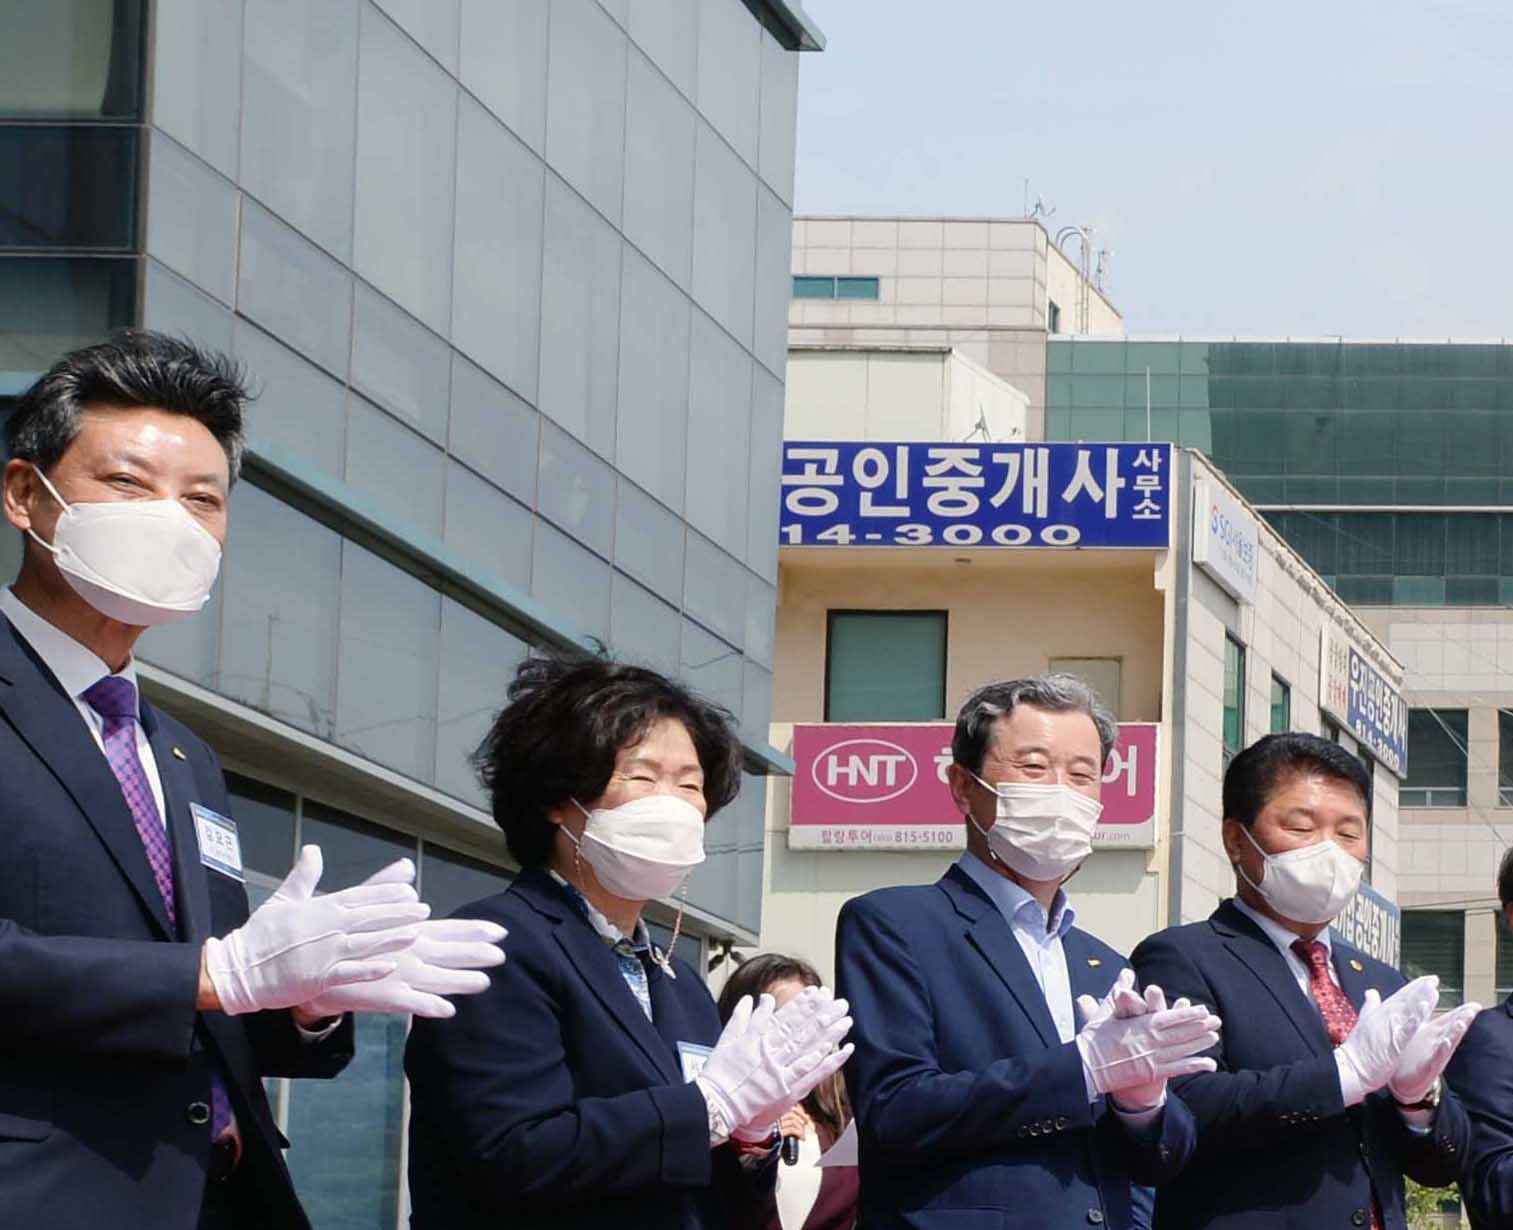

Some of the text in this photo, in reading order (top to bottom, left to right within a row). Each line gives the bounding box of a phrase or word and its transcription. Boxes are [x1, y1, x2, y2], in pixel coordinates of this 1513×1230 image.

[782, 445, 1126, 519] 공인중개사
[1132, 448, 1163, 520] 사무소
[827, 755, 906, 787] HNT
